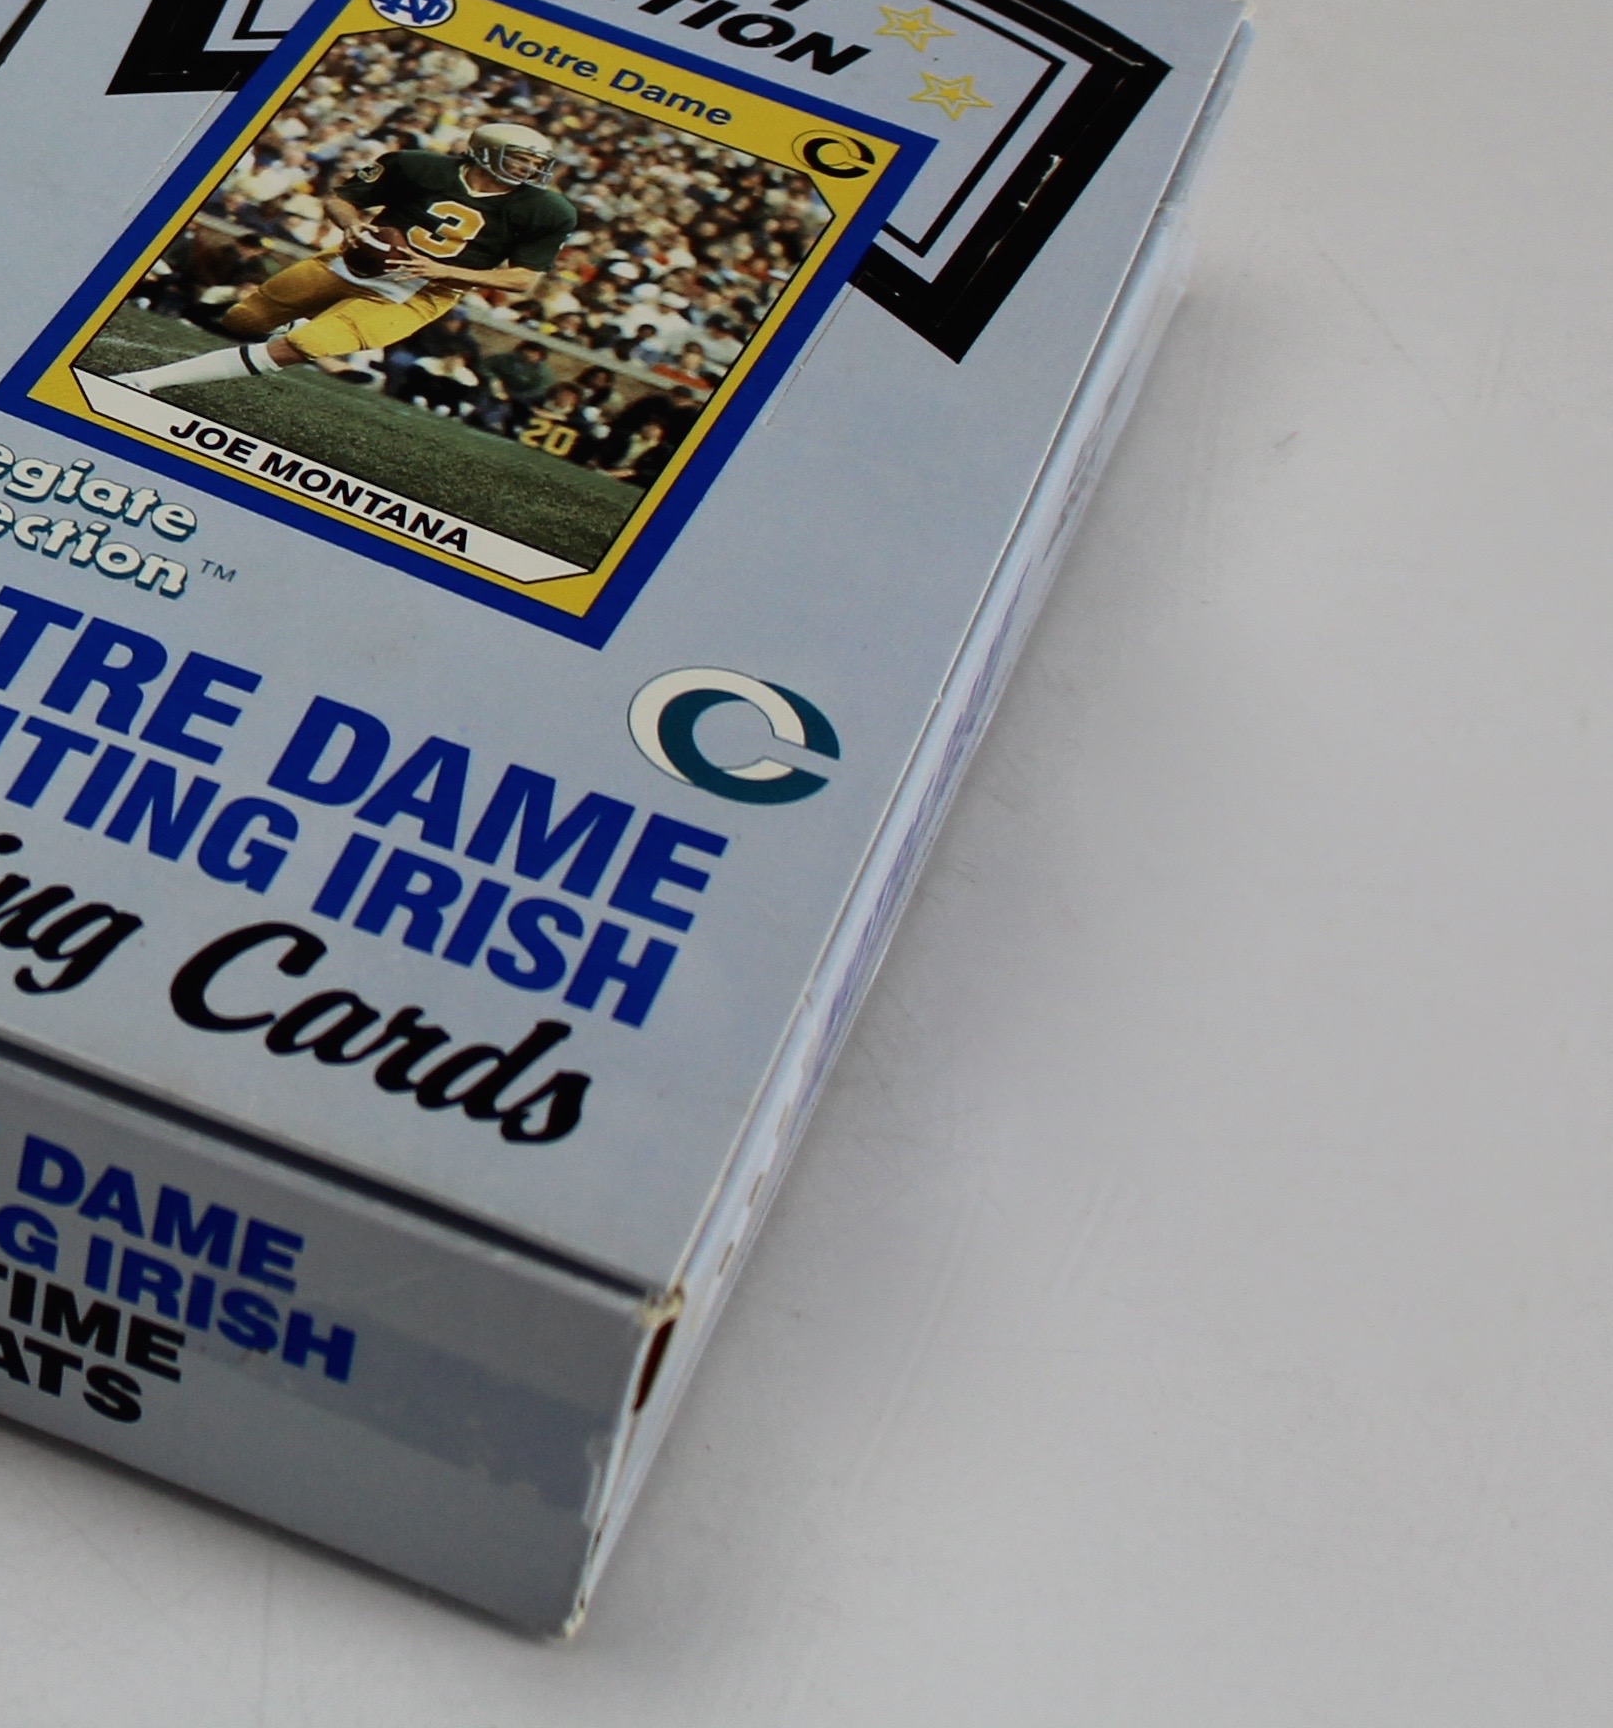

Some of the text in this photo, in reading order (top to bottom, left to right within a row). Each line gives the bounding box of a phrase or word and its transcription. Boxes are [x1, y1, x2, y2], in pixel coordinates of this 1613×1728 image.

[484, 23, 732, 125] Notre Dame
[407, 200, 486, 258] 3
[170, 419, 470, 555] JOE MONTANA
[268, 694, 730, 933] DAME
[311, 838, 679, 1031] IRISH
[170, 921, 593, 1146] Cards
[17, 1134, 306, 1295] DAME
[85, 1240, 356, 1385] IRISH
